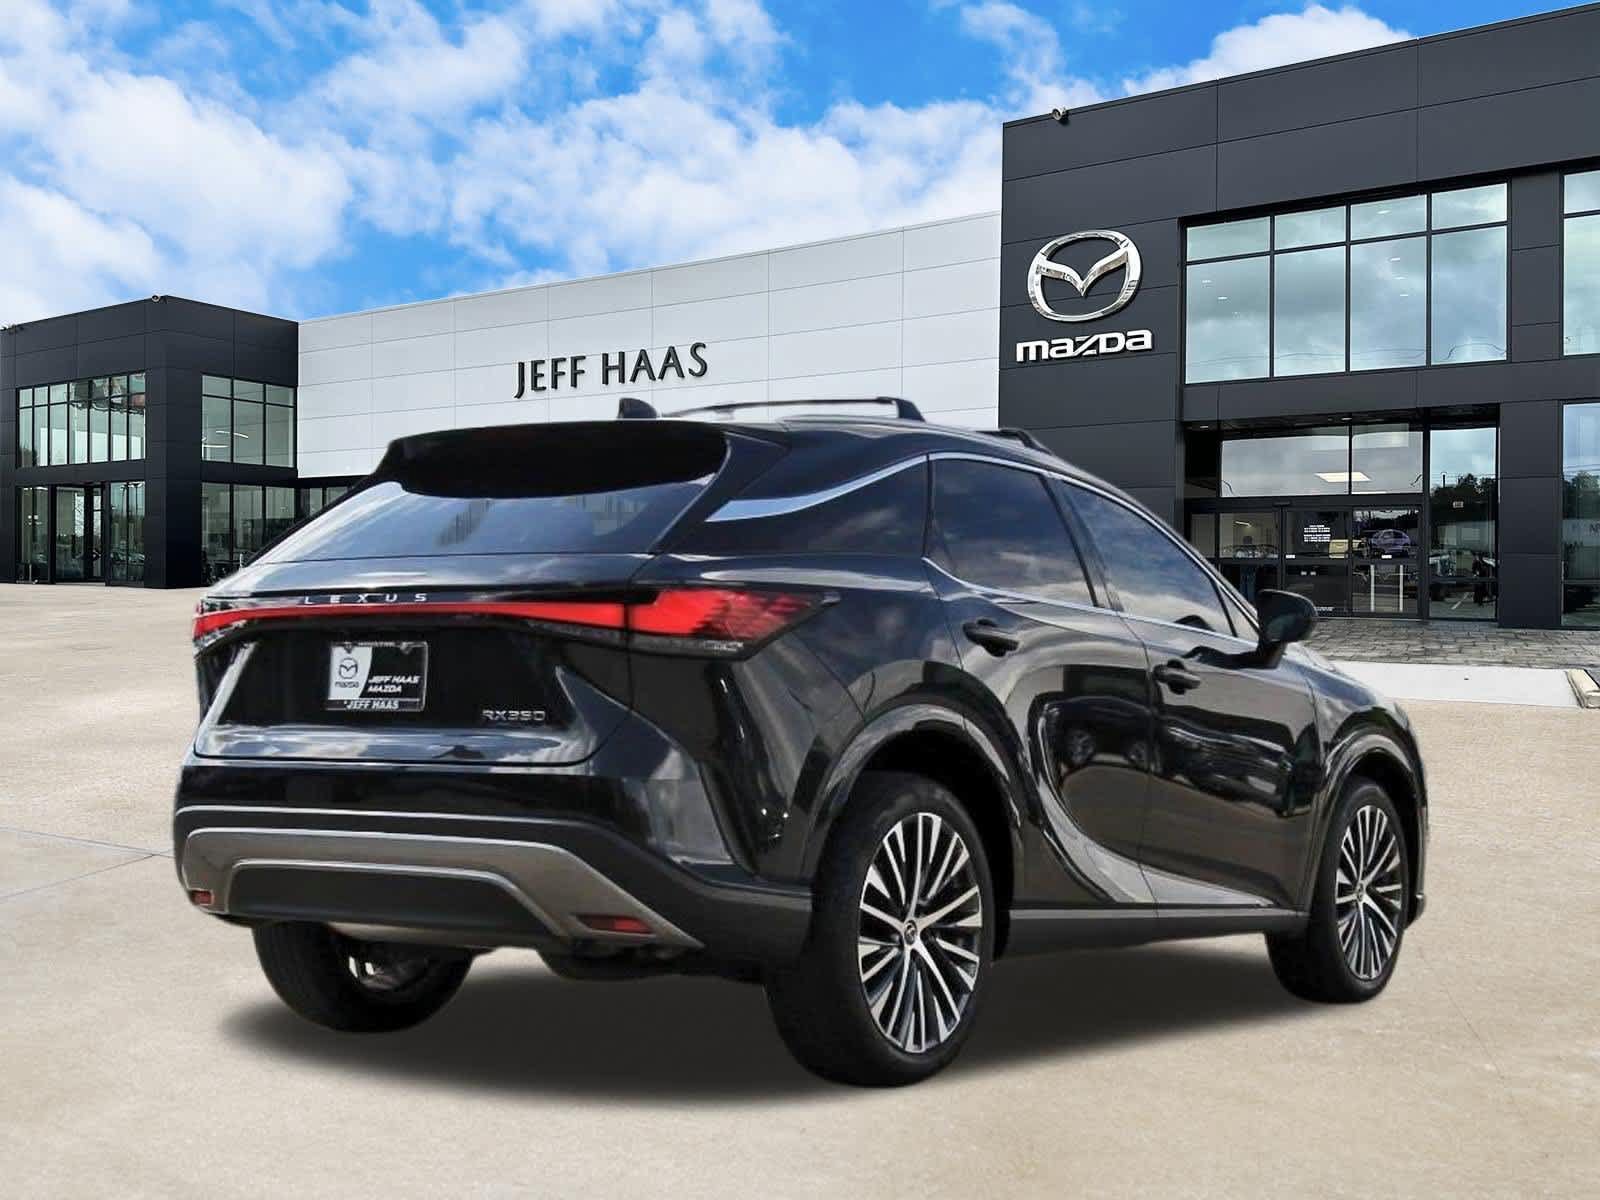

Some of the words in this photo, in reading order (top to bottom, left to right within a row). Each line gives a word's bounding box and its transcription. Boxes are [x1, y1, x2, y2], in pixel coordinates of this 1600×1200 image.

[514, 355, 586, 399] JEFF
[602, 342, 708, 385] HAAS
[304, 593, 427, 605] LEXUS
[368, 675, 392, 684] JEFF
[391, 675, 420, 684] HAAS
[367, 684, 402, 693] MAZDA
[346, 700, 371, 710] JEFF
[371, 700, 400, 710] HAAS
[482, 709, 546, 721] RX350
